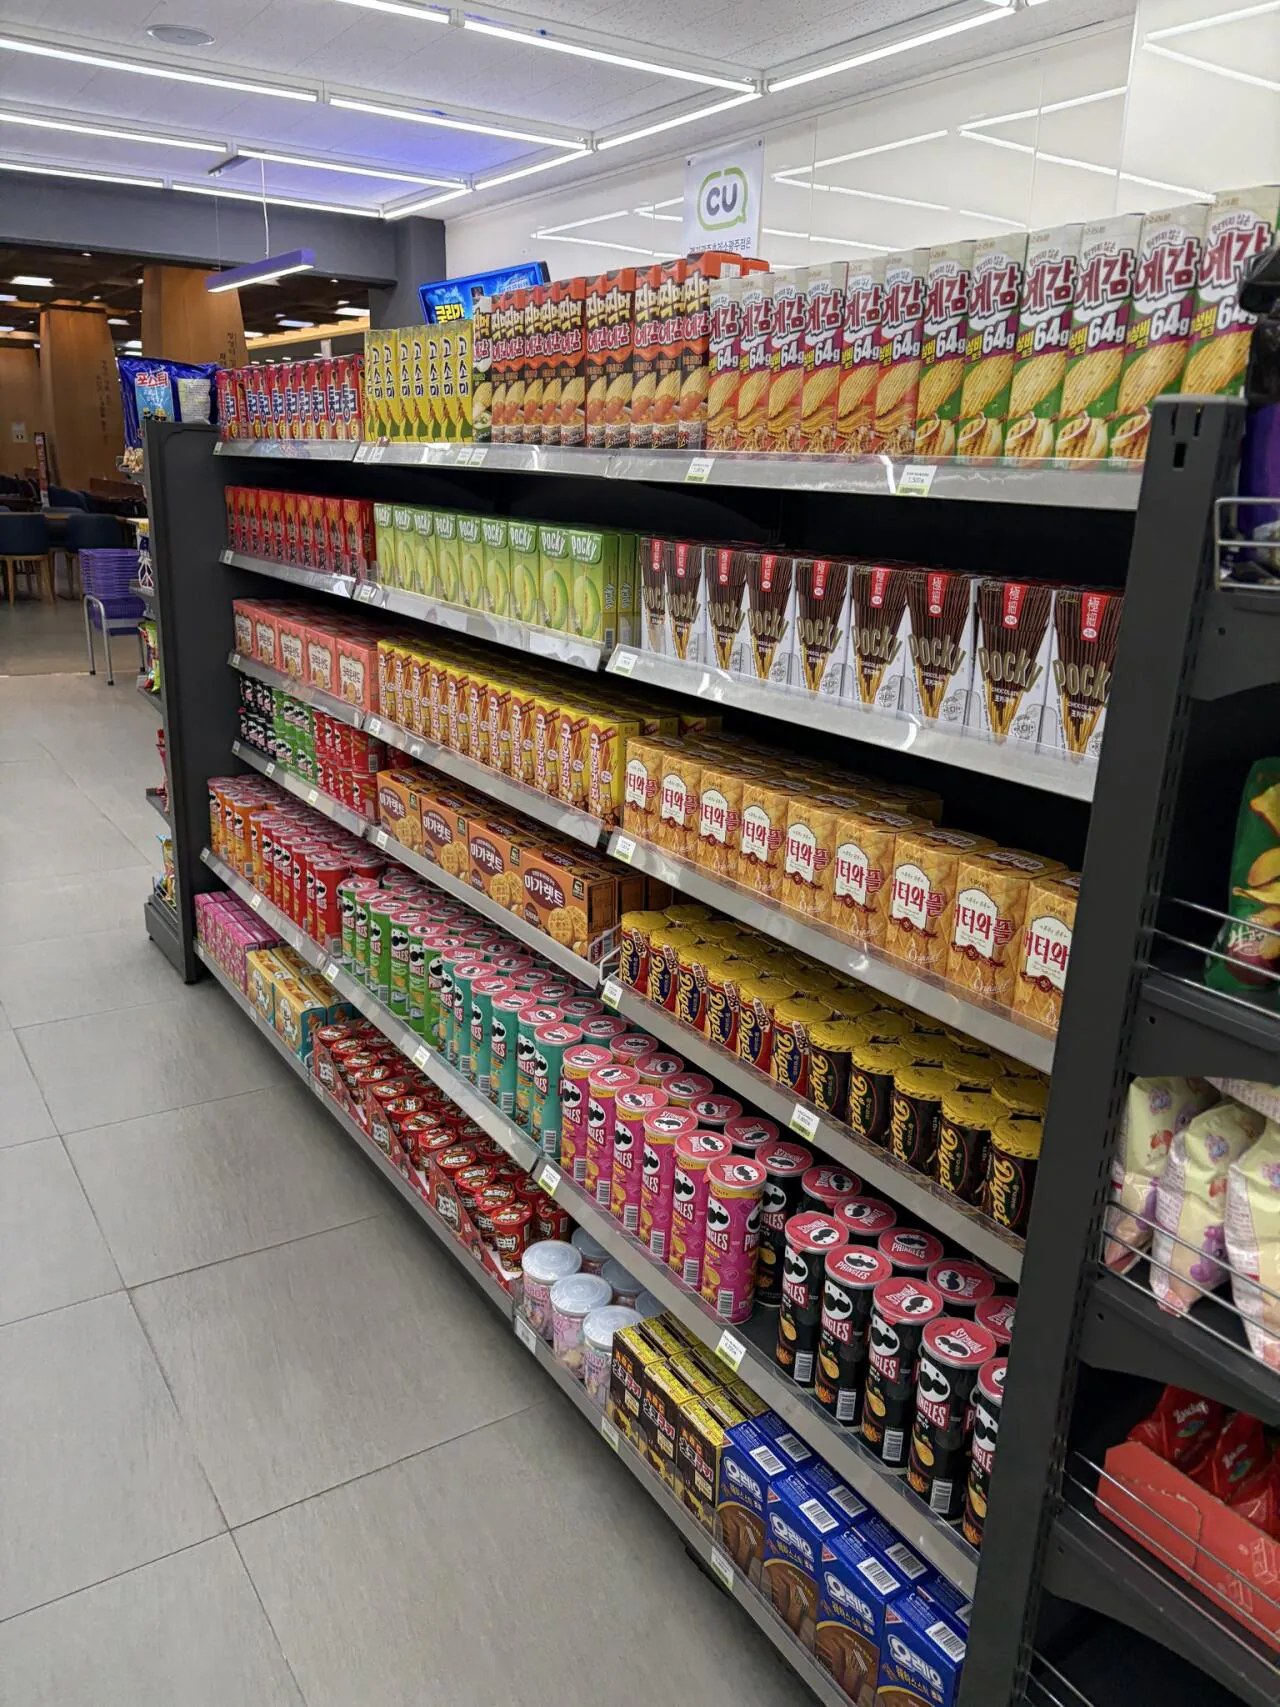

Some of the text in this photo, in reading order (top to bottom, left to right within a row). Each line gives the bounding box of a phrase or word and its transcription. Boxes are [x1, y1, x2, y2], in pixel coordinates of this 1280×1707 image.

[706, 184, 737, 216] CU
[982, 321, 1014, 350] 64g
[1034, 317, 1070, 351] 64g
[1087, 312, 1126, 348] 64g
[1150, 303, 1190, 340] 64g
[936, 325, 966, 357] 64g
[525, 874, 564, 907] 마가렛트
[892, 1242, 927, 1260] PRINGLES
[835, 1261, 870, 1281] PRINGLES
